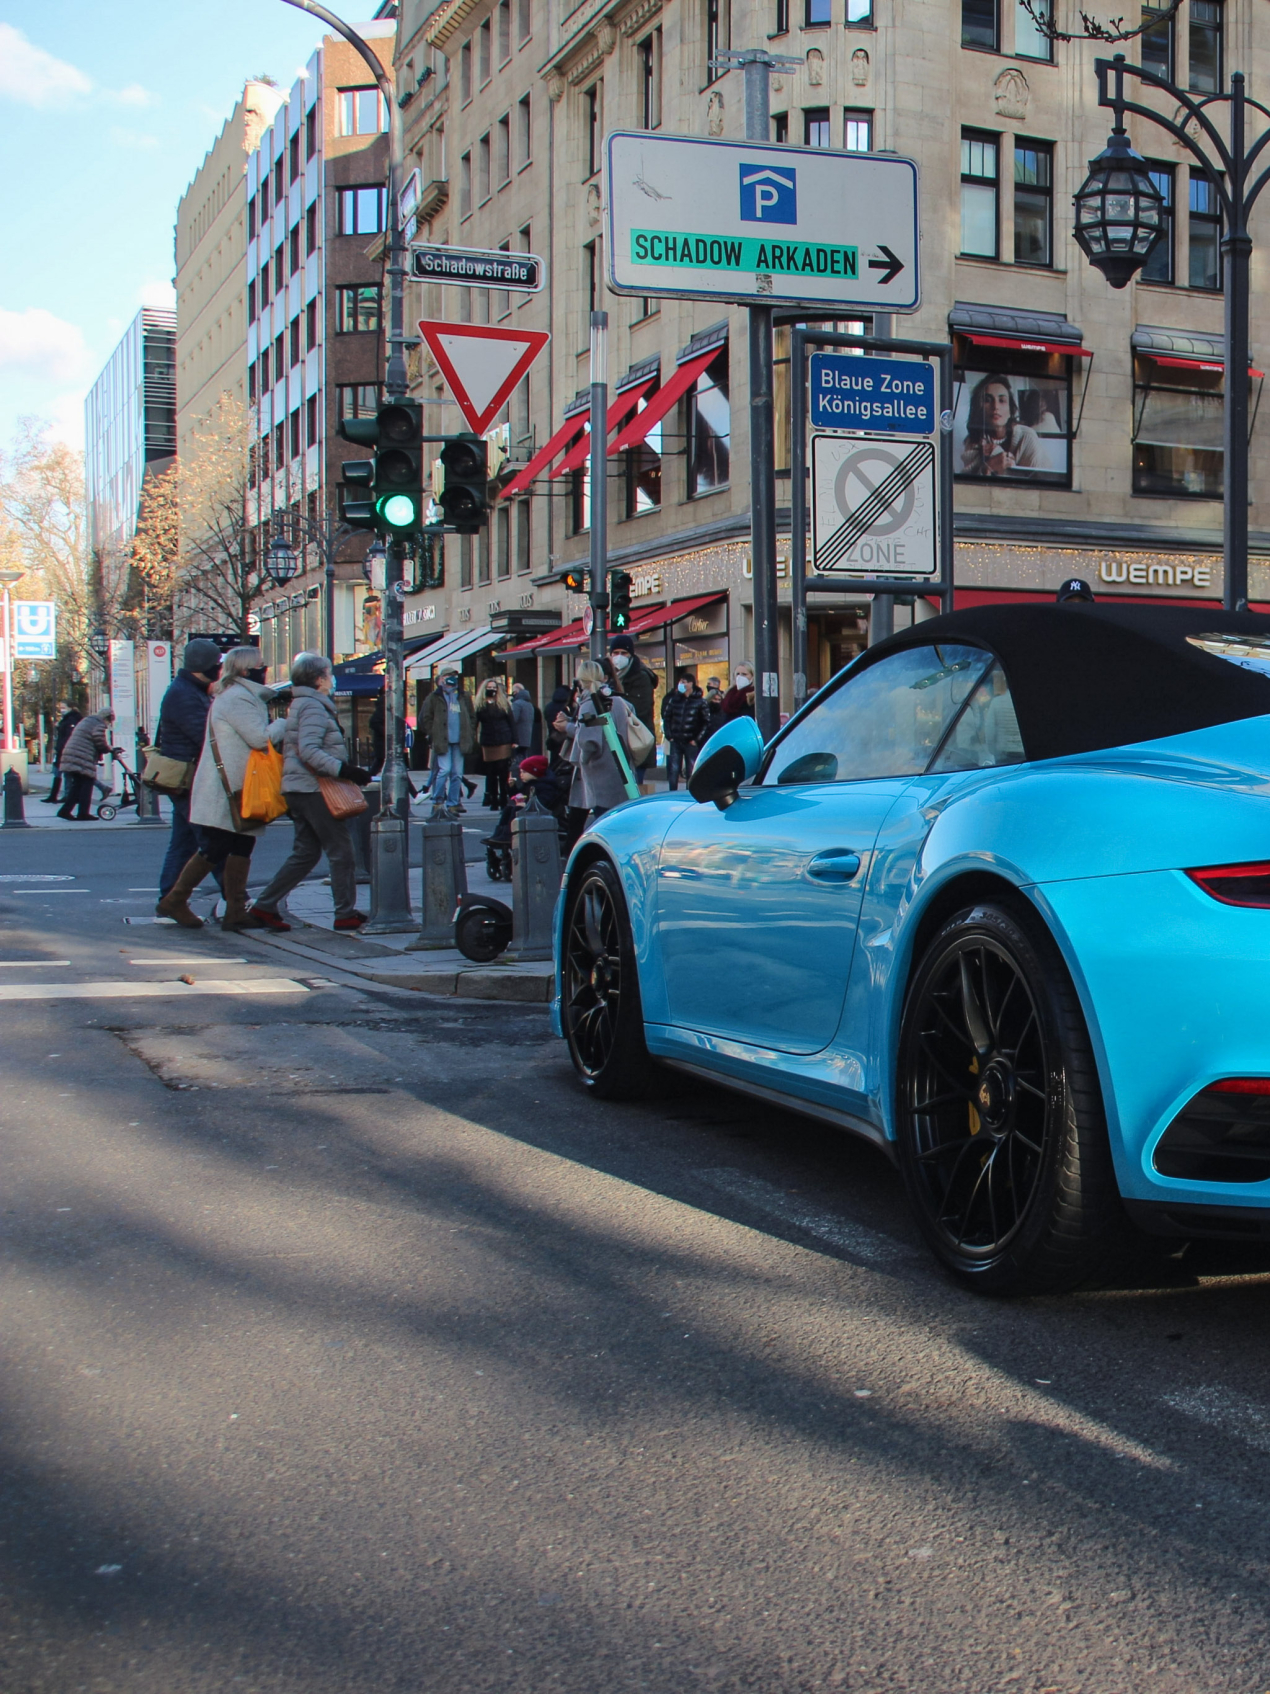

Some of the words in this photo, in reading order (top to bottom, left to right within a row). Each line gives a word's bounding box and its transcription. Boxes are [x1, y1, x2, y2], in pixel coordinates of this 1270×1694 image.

[425, 255, 527, 280] Schadowstraße
[635, 234, 742, 267] SCHADOW
[756, 243, 856, 276] ARKADEN
[821, 369, 873, 391] Blaue
[880, 374, 925, 395] Zone
[819, 394, 927, 420] Königsallee
[846, 542, 906, 564] ZONE
[629, 574, 660, 598] EMPE
[1101, 562, 1211, 587] WEMPE
